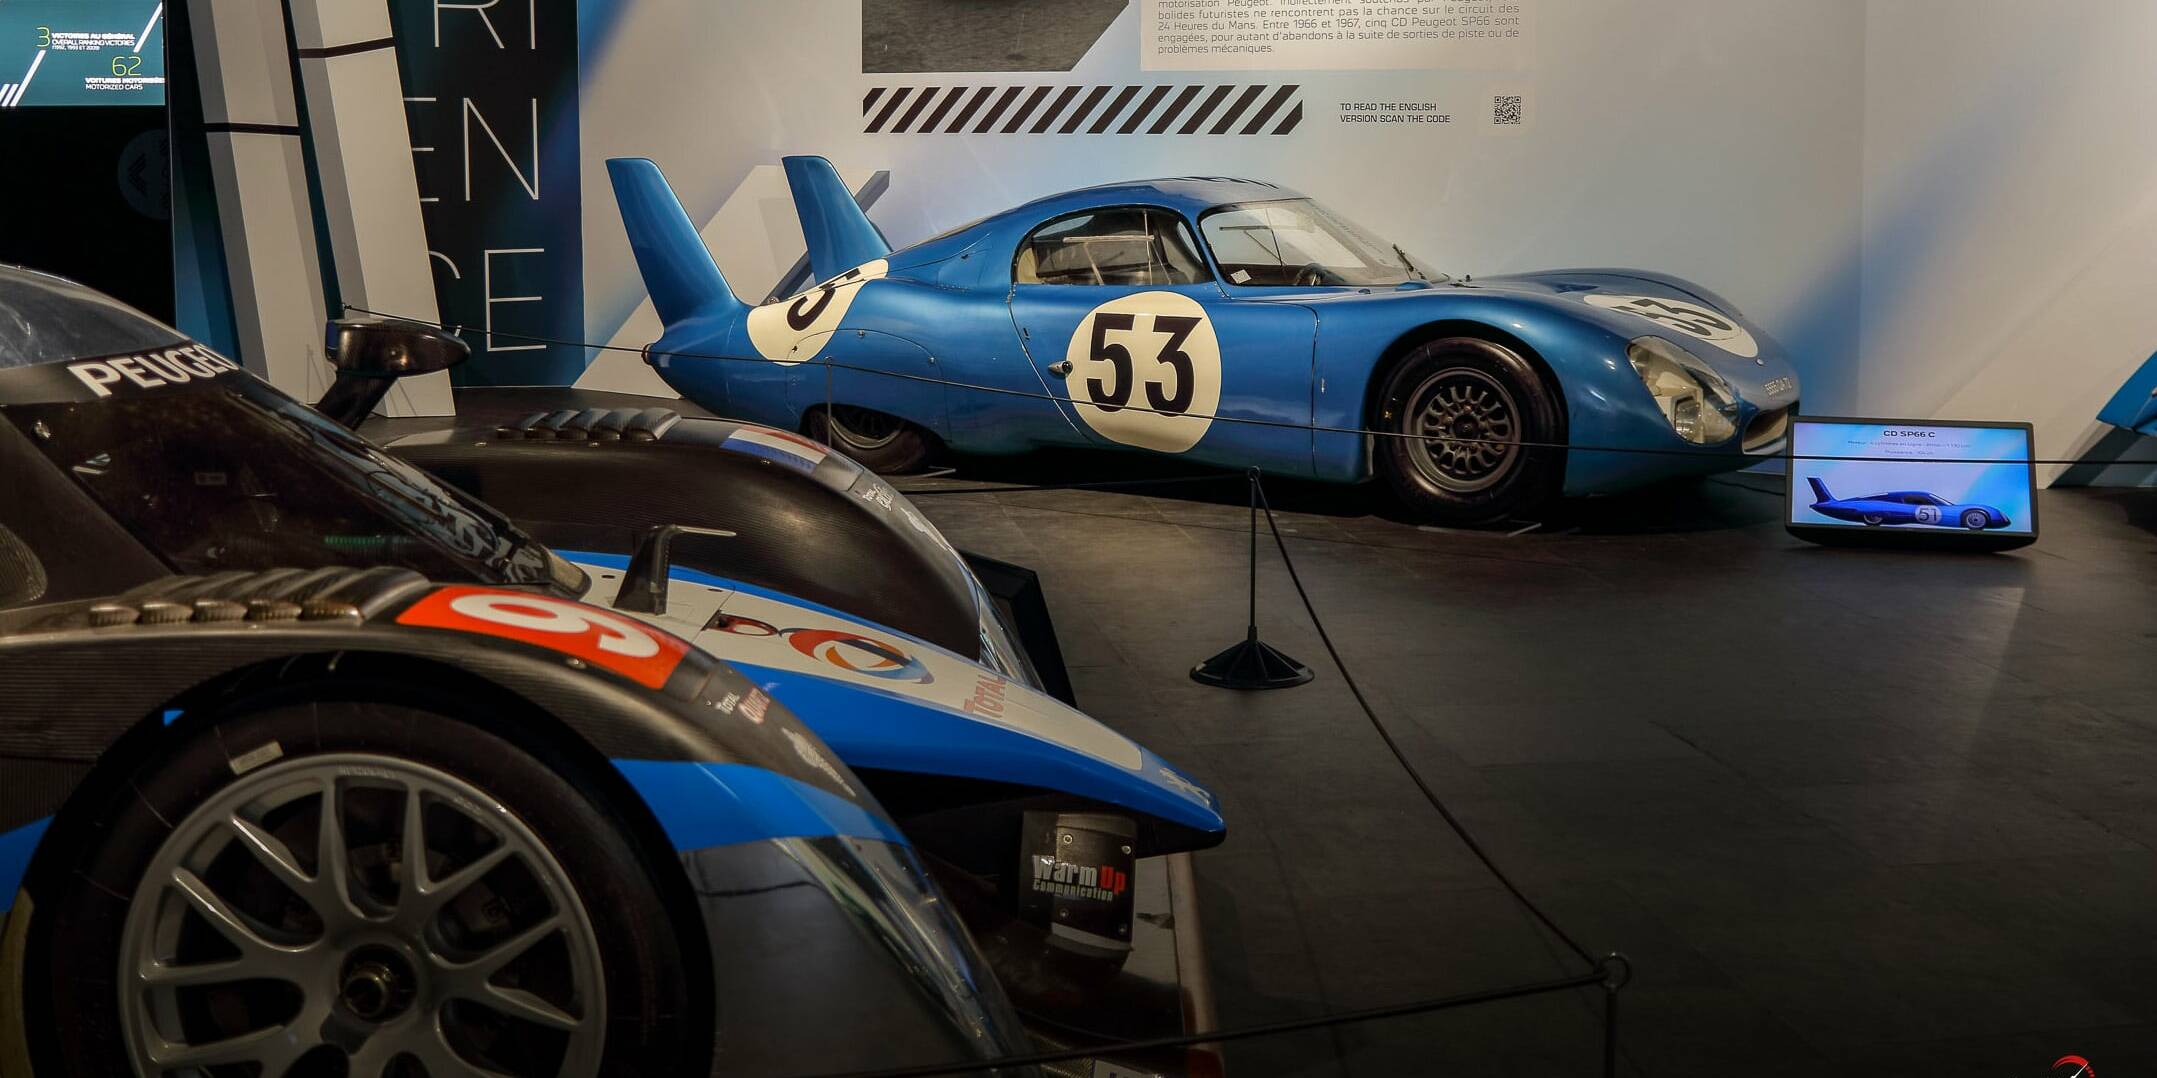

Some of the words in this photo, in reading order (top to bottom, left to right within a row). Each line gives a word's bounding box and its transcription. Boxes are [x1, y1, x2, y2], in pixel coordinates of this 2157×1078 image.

[1158, 11, 1195, 20] bolides
[1199, 10, 1250, 19] futuristes
[1253, 10, 1267, 18] ne
[1271, 9, 1334, 18] rencontrent
[1338, 8, 1359, 17] pas
[1363, 6, 1373, 16] la
[1377, 6, 1418, 15] chance
[1422, 7, 1441, 15] sur
[1444, 5, 1455, 14] le
[1458, 4, 1494, 14] circuit
[1498, 4, 1520, 14] des
[1158, 21, 1170, 31] 24
[1174, 21, 1208, 31] Heures
[1211, 21, 1225, 31] du
[1262, 20, 1290, 30] Entre
[1293, 19, 1318, 29] 1966
[1321, 20, 1332, 29] et
[1335, 18, 1361, 29] 1967,
[1365, 18, 1387, 29] cinq
[1391, 17, 1408, 27] CD
[1411, 16, 1457, 29] Peugeot
[1461, 16, 1490, 26] SP66
[1494, 16, 1520, 26] sont
[36, 26, 50, 47] 3
[104, 39, 135, 47] VICTORIES
[1158, 33, 1208, 43] engagées,
[1211, 34, 1234, 43] pour
[1236, 33, 1270, 42] autant
[1272, 31, 1334, 41] d'abandons
[1336, 30, 1343, 40] à
[1346, 30, 1355, 40] la
[1358, 30, 1384, 40] suite
[1386, 29, 1400, 39] de
[1403, 29, 1439, 39] sorties
[1441, 29, 1455, 39] de
[1458, 28, 1485, 40] piste
[1488, 29, 1501, 38] ou
[1505, 28, 1520, 38] de
[1158, 44, 1209, 54] problèmes
[112, 56, 142, 77] 62
[1339, 103, 1352, 111] TO
[1353, 103, 1377, 111] READ
[1379, 103, 1397, 111] THE
[1399, 103, 1437, 111] ENGLISH
[1339, 114, 1378, 123] VERSION
[1379, 114, 1405, 123] SCAN
[1406, 114, 1424, 123] THE
[1426, 114, 1451, 123] CODE
[1086, 312, 1203, 417] 53
[1900, 430, 1926, 438] SP66
[1917, 507, 1938, 522] 51
[1031, 878, 1114, 902] Communication
